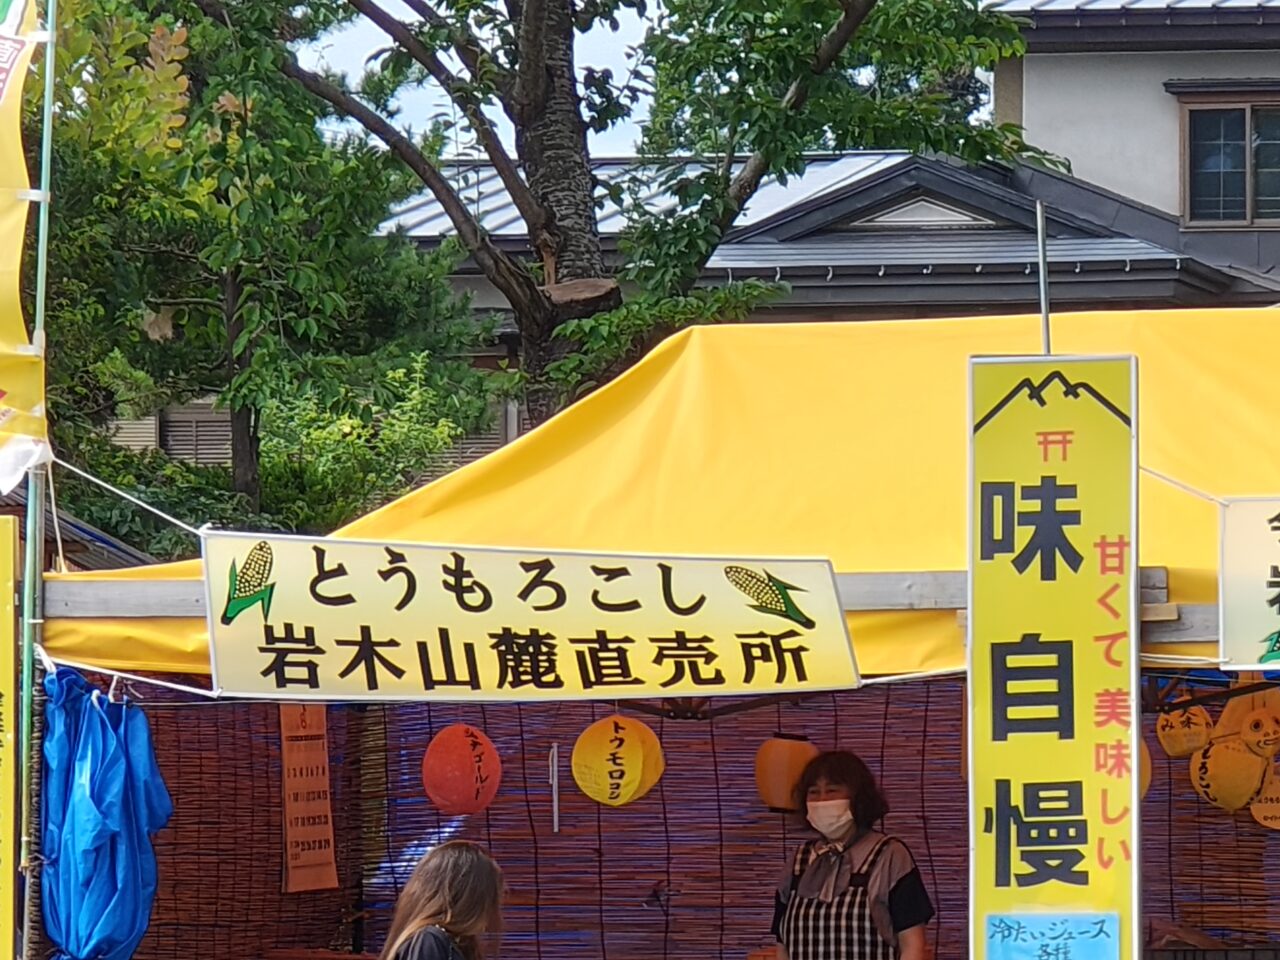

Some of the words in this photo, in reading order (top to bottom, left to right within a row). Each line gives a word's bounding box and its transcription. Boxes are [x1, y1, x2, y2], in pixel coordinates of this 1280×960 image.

[257, 621, 811, 690] 岩木山麓直売所
[311, 545, 707, 613] とうもろこし
[980, 475, 1089, 888] 味自慢
[1093, 534, 1132, 870] 甘くて美味しい
